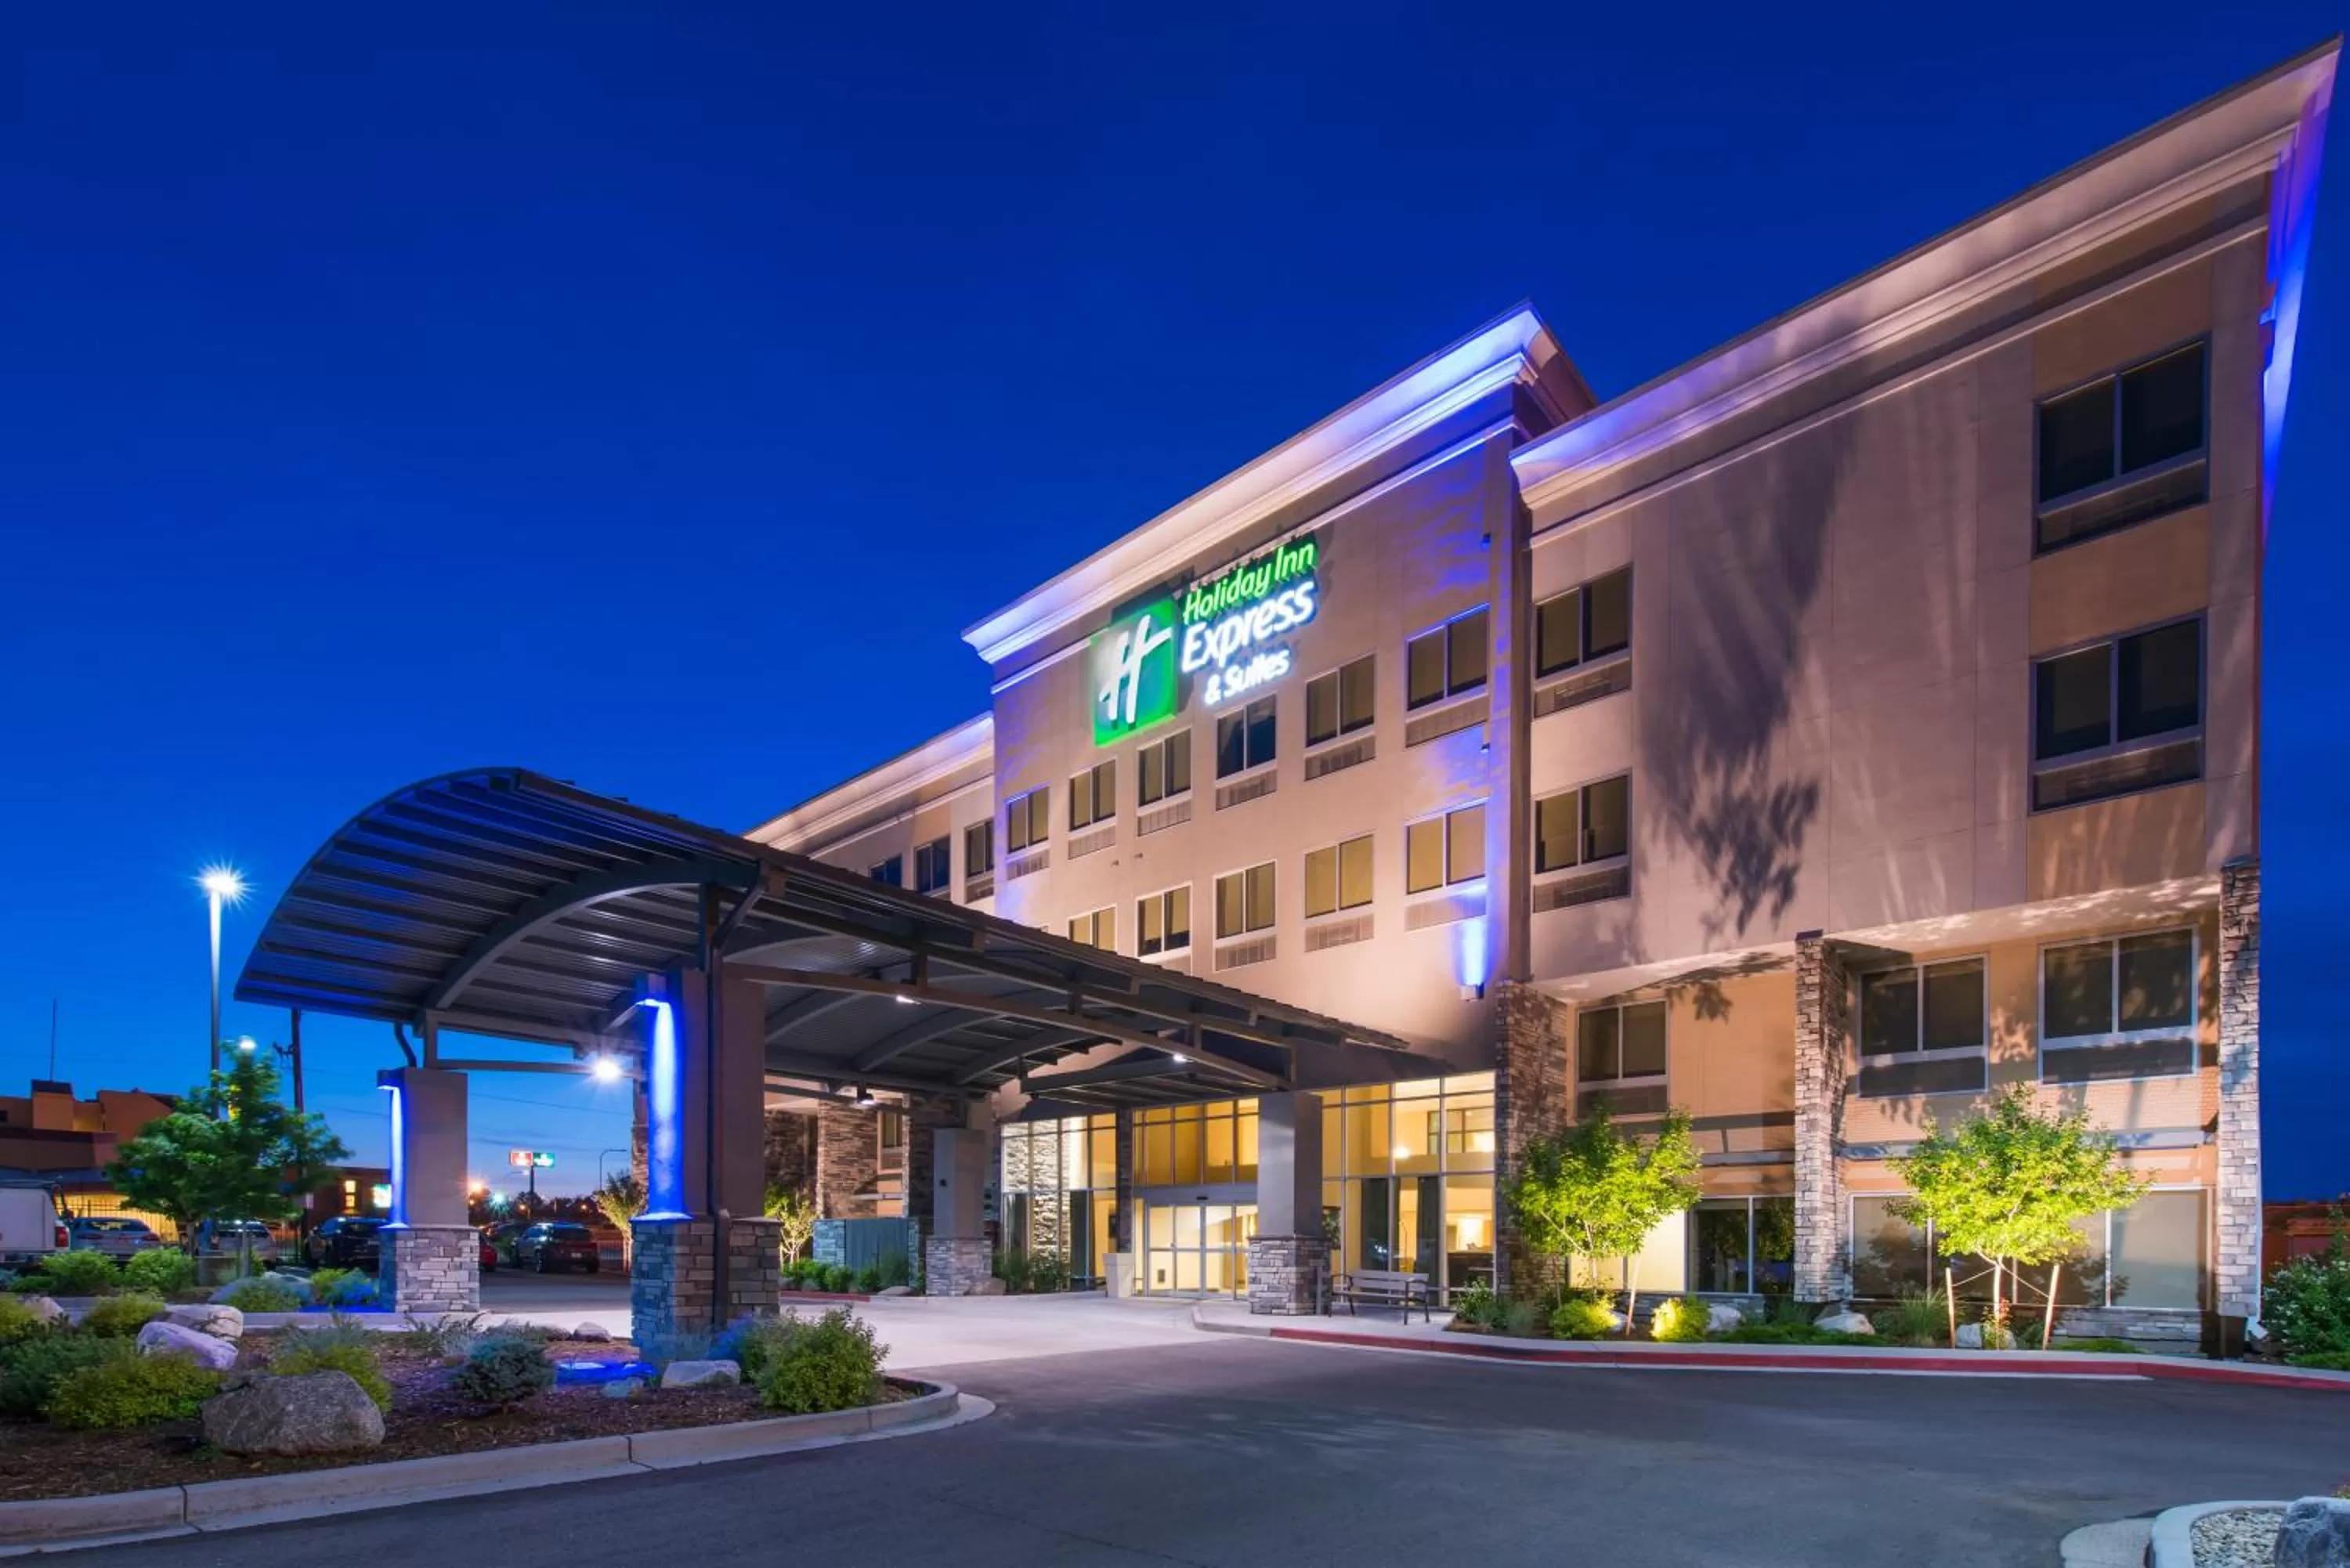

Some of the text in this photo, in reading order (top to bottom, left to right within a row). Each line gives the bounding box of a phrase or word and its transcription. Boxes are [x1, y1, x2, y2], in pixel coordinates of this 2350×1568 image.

[1183, 543, 1314, 625] Holiday Inn
[1182, 581, 1315, 673] Express
[1205, 649, 1290, 704] & Suites
